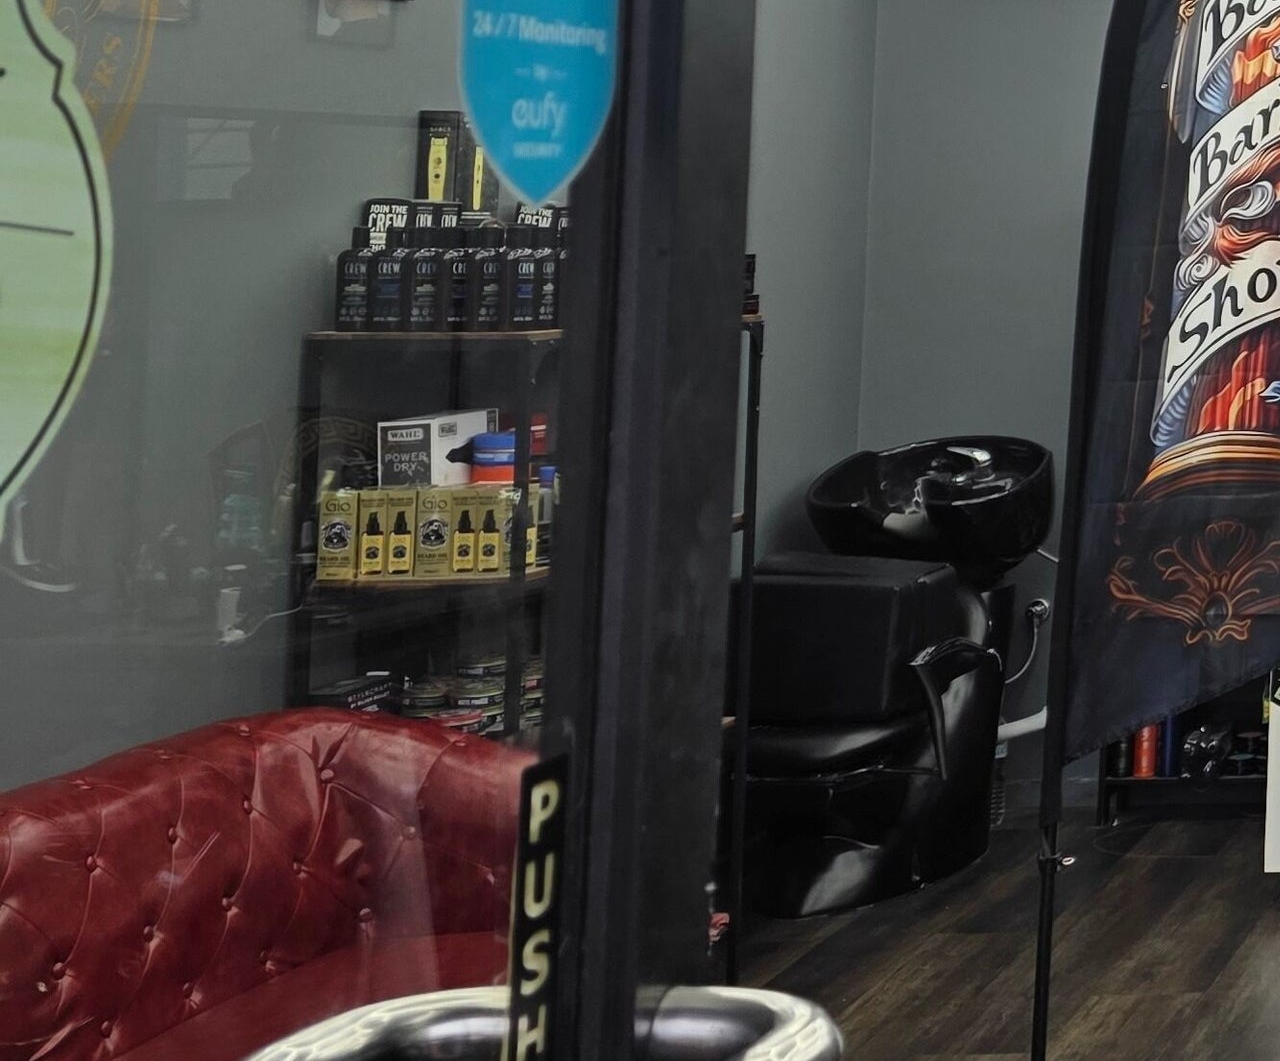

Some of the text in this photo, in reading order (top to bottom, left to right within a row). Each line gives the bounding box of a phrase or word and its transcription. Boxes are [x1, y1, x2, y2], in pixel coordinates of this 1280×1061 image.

[518, 15, 606, 56] Monitoring
[511, 91, 568, 138] eufy
[369, 204, 409, 214] JOIN THE
[368, 213, 408, 232] CREW
[344, 262, 367, 275] CREW
[377, 262, 401, 275] CREW
[389, 429, 421, 439] WAHL
[384, 451, 429, 464] POWER
[393, 462, 418, 472] DRY
[516, 780, 560, 1061] PUSH
